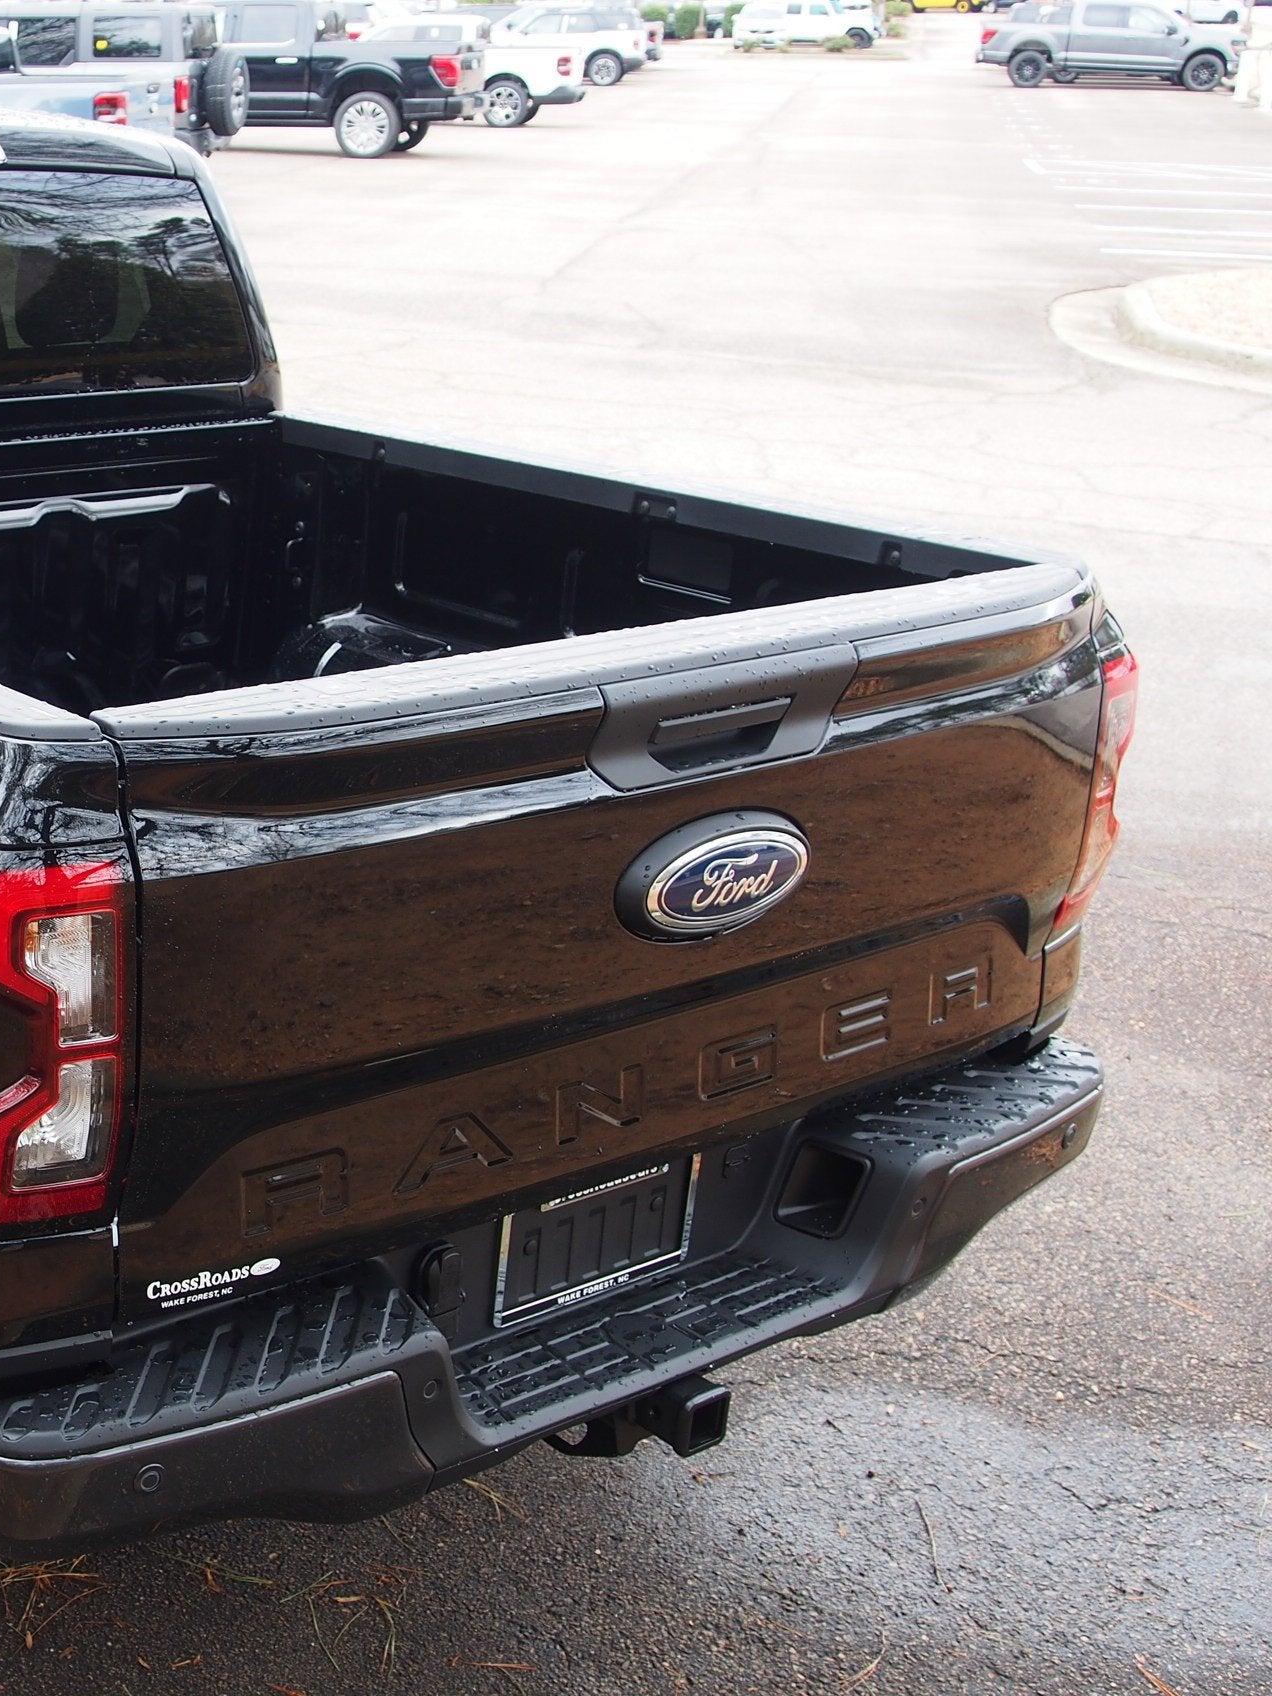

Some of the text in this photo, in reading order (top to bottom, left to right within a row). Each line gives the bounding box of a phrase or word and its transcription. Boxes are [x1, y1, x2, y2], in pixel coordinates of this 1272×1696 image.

[690, 852, 779, 912] Ford
[241, 965, 993, 1238] RANGER
[161, 1286, 234, 1309] WAKE FOREST, NC
[557, 1273, 631, 1305] WAKE FOREST, NC
